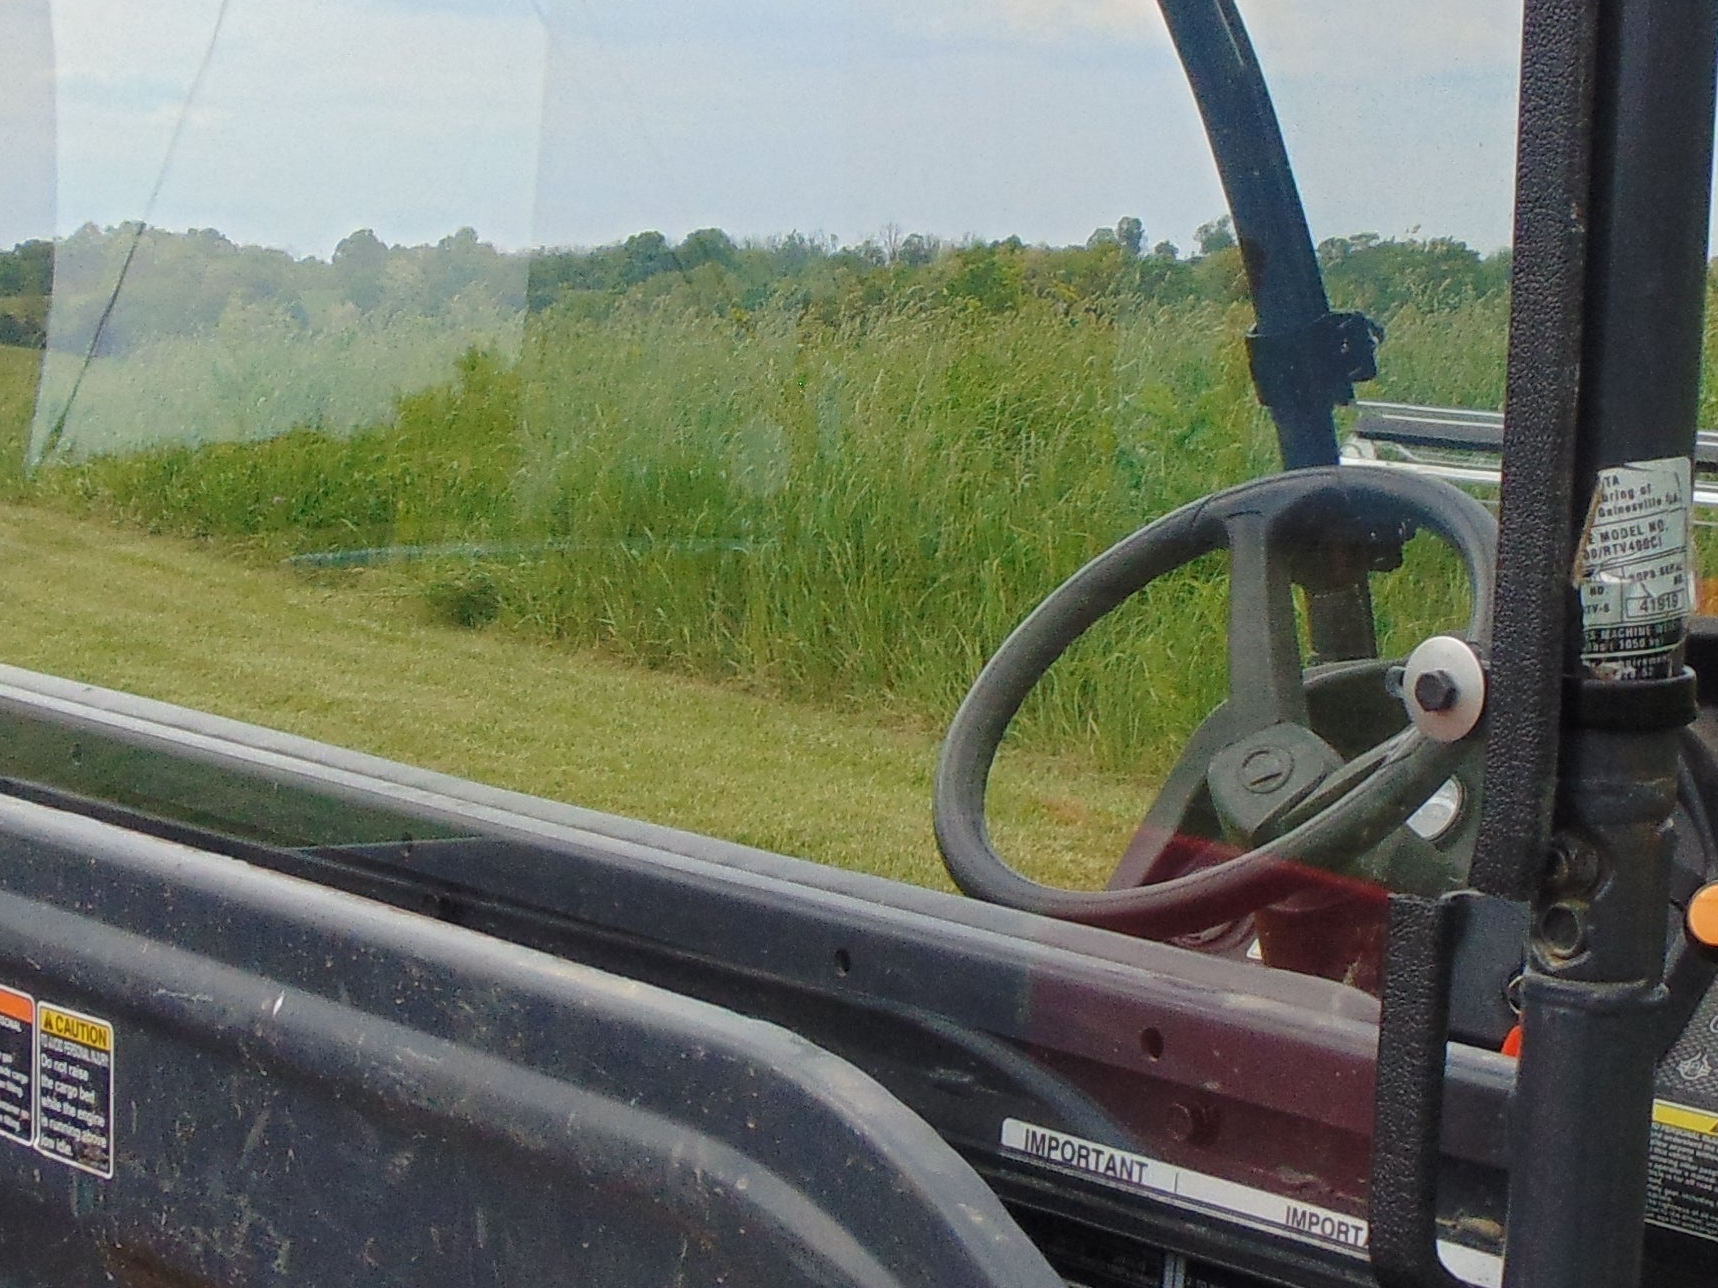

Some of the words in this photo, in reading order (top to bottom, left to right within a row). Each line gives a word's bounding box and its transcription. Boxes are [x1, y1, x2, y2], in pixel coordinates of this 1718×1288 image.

[1600, 525, 1645, 543] MODEL
[1639, 593, 1679, 614] 41919
[1600, 625, 1651, 641] MACHINE
[55, 1015, 107, 1048] CAUTION
[41, 1053, 52, 1069] Do
[53, 1059, 67, 1074] not
[68, 1064, 89, 1083] raise
[41, 1074, 54, 1090] the
[55, 1080, 78, 1100] cargo
[79, 1086, 96, 1105] bed
[41, 1096, 62, 1113] while
[62, 1102, 76, 1118] the
[77, 1108, 105, 1128] engine
[49, 1119, 81, 1142] running
[1024, 1128, 1149, 1186] IMPORTANT
[1284, 1205, 1365, 1248] IMPORT
